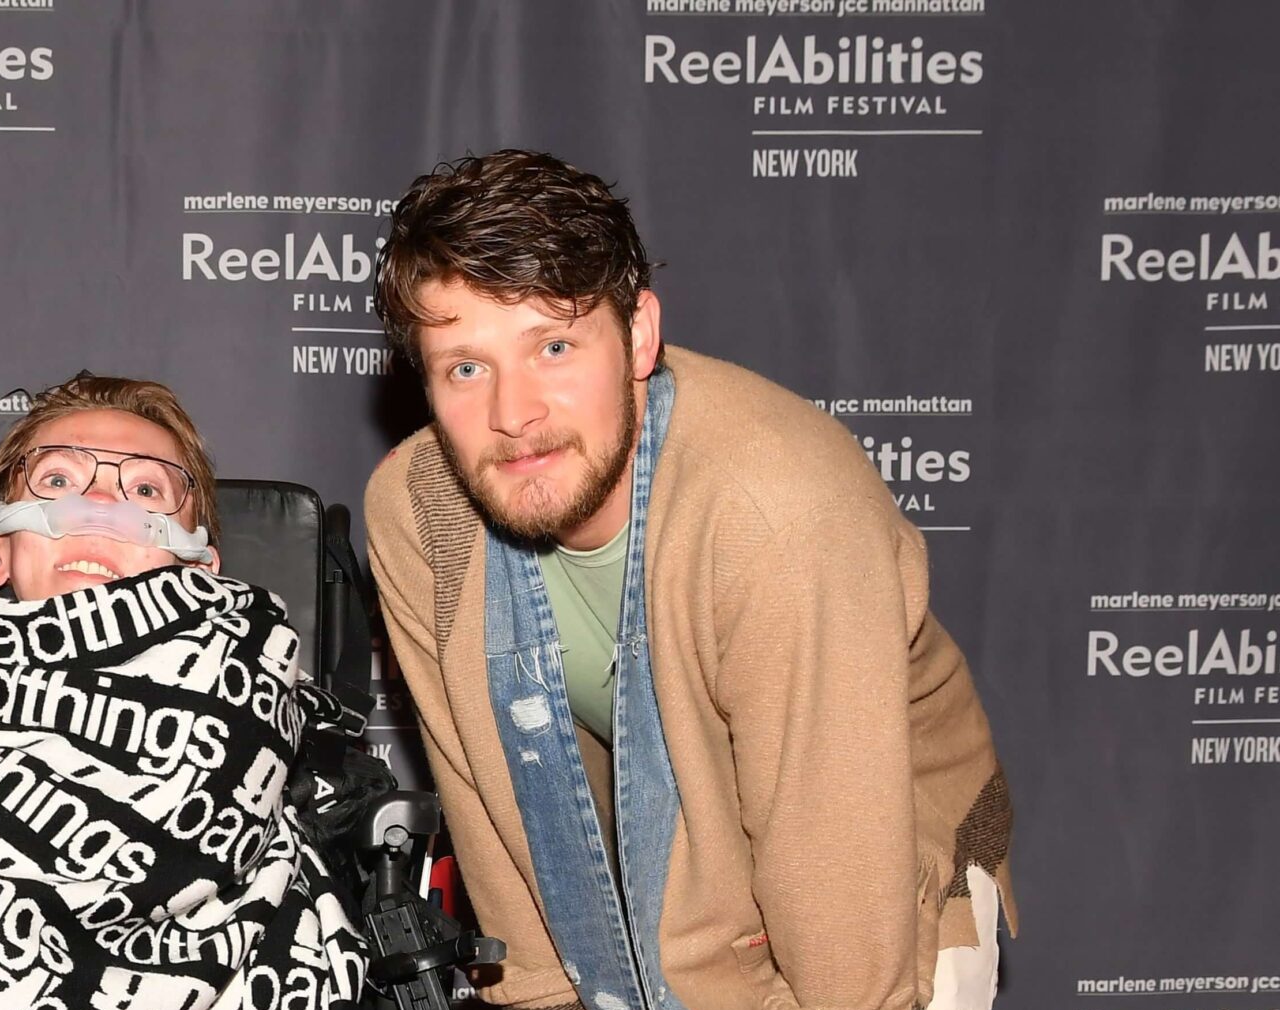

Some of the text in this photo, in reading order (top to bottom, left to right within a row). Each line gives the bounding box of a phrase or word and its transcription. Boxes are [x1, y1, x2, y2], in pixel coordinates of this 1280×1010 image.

[735, 0, 834, 16] meyerson
[644, 35, 983, 84] ReelAbilities
[754, 97, 947, 114] FILM FESTIVAL
[753, 149, 858, 177] NEW YORK
[184, 192, 268, 210] marlene
[273, 197, 371, 214] meyerson
[1104, 192, 1280, 214] marlene meyerso
[293, 294, 352, 312] FILM
[1207, 292, 1268, 311] FILM
[293, 346, 338, 374] NEW
[1205, 344, 1253, 372] NEW
[863, 395, 972, 413] manhattan
[1091, 591, 1174, 608] marlene
[1178, 593, 1267, 611] meyerson
[1194, 688, 1244, 704] FILM
[1191, 737, 1230, 764] NEW
[1077, 976, 1156, 992] marlene
[1160, 976, 1249, 993] meyerson
